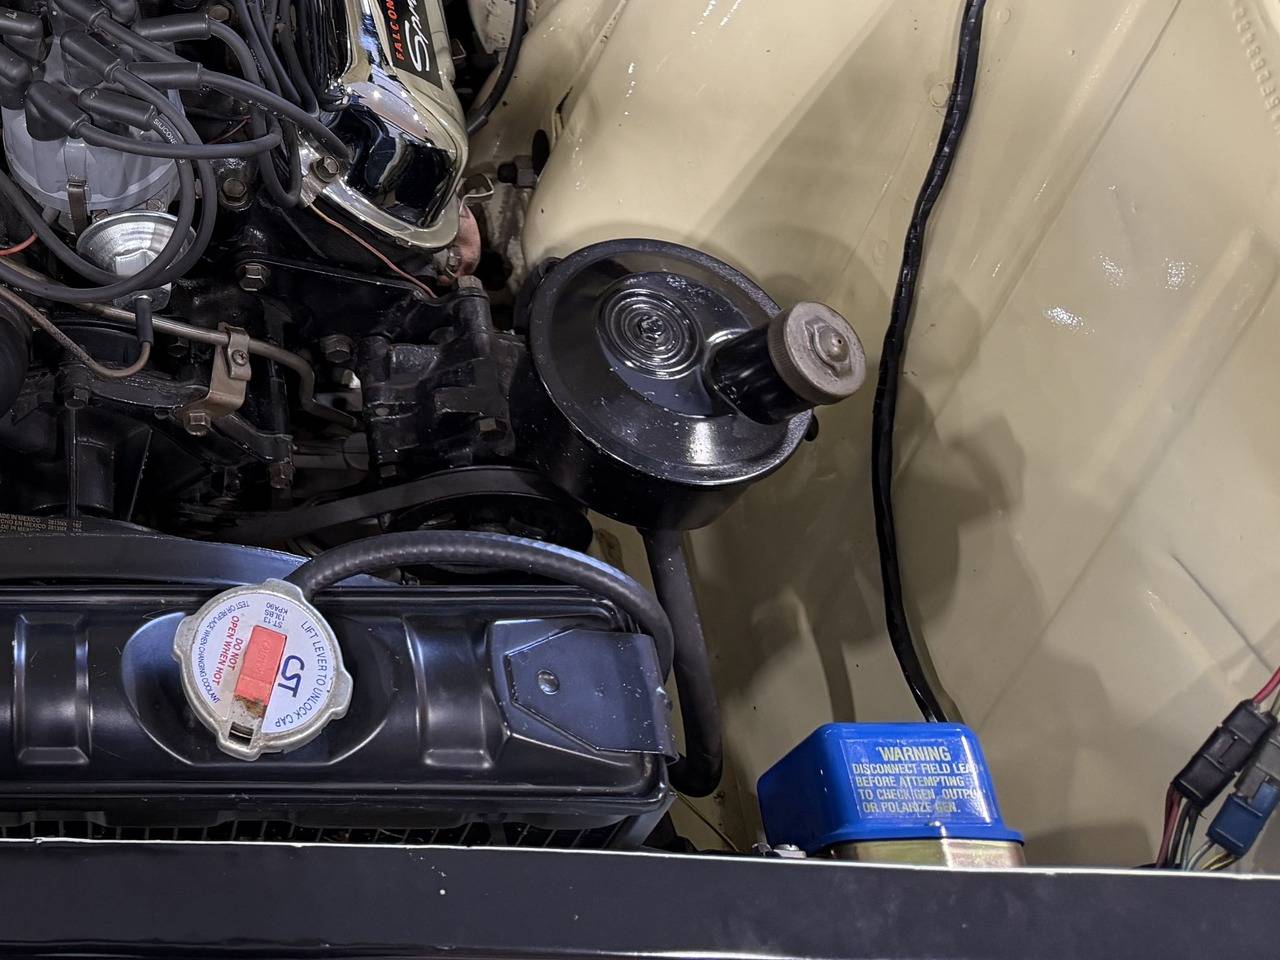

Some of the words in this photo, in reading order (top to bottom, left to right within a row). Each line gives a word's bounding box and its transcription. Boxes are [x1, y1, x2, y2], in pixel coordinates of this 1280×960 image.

[226, 605, 236, 614] OR
[236, 600, 250, 610] TEST
[266, 602, 288, 614] KPA90
[207, 610, 228, 630] REPLACE
[264, 609, 285, 621] 13LBS
[226, 616, 240, 639] OPEN
[300, 620, 318, 640] LIFT
[200, 629, 211, 646] WHEN
[233, 638, 243, 651] DO
[219, 640, 232, 666] WHEN
[312, 640, 327, 671] LEVER
[198, 646, 207, 677] CHANGING
[228, 653, 239, 670] NOT
[212, 666, 224, 686] HOT
[316, 674, 327, 686] TO
[202, 677, 220, 704] COOLANT
[294, 688, 323, 720] UNLOCK
[275, 713, 293, 728] CAP
[877, 745, 952, 761] WARNING
[852, 763, 918, 774] DISCONNECT
[920, 763, 950, 774] FIELD
[856, 776, 897, 787] BEFORE
[900, 775, 964, 787] ATTEMPTING
[857, 789, 873, 800] TO
[876, 789, 911, 800] CHECK
[942, 788, 978, 800] OUTPU
[862, 801, 879, 812] OR
[880, 801, 932, 812] POLARIZE
[936, 802, 961, 813] GEN.
